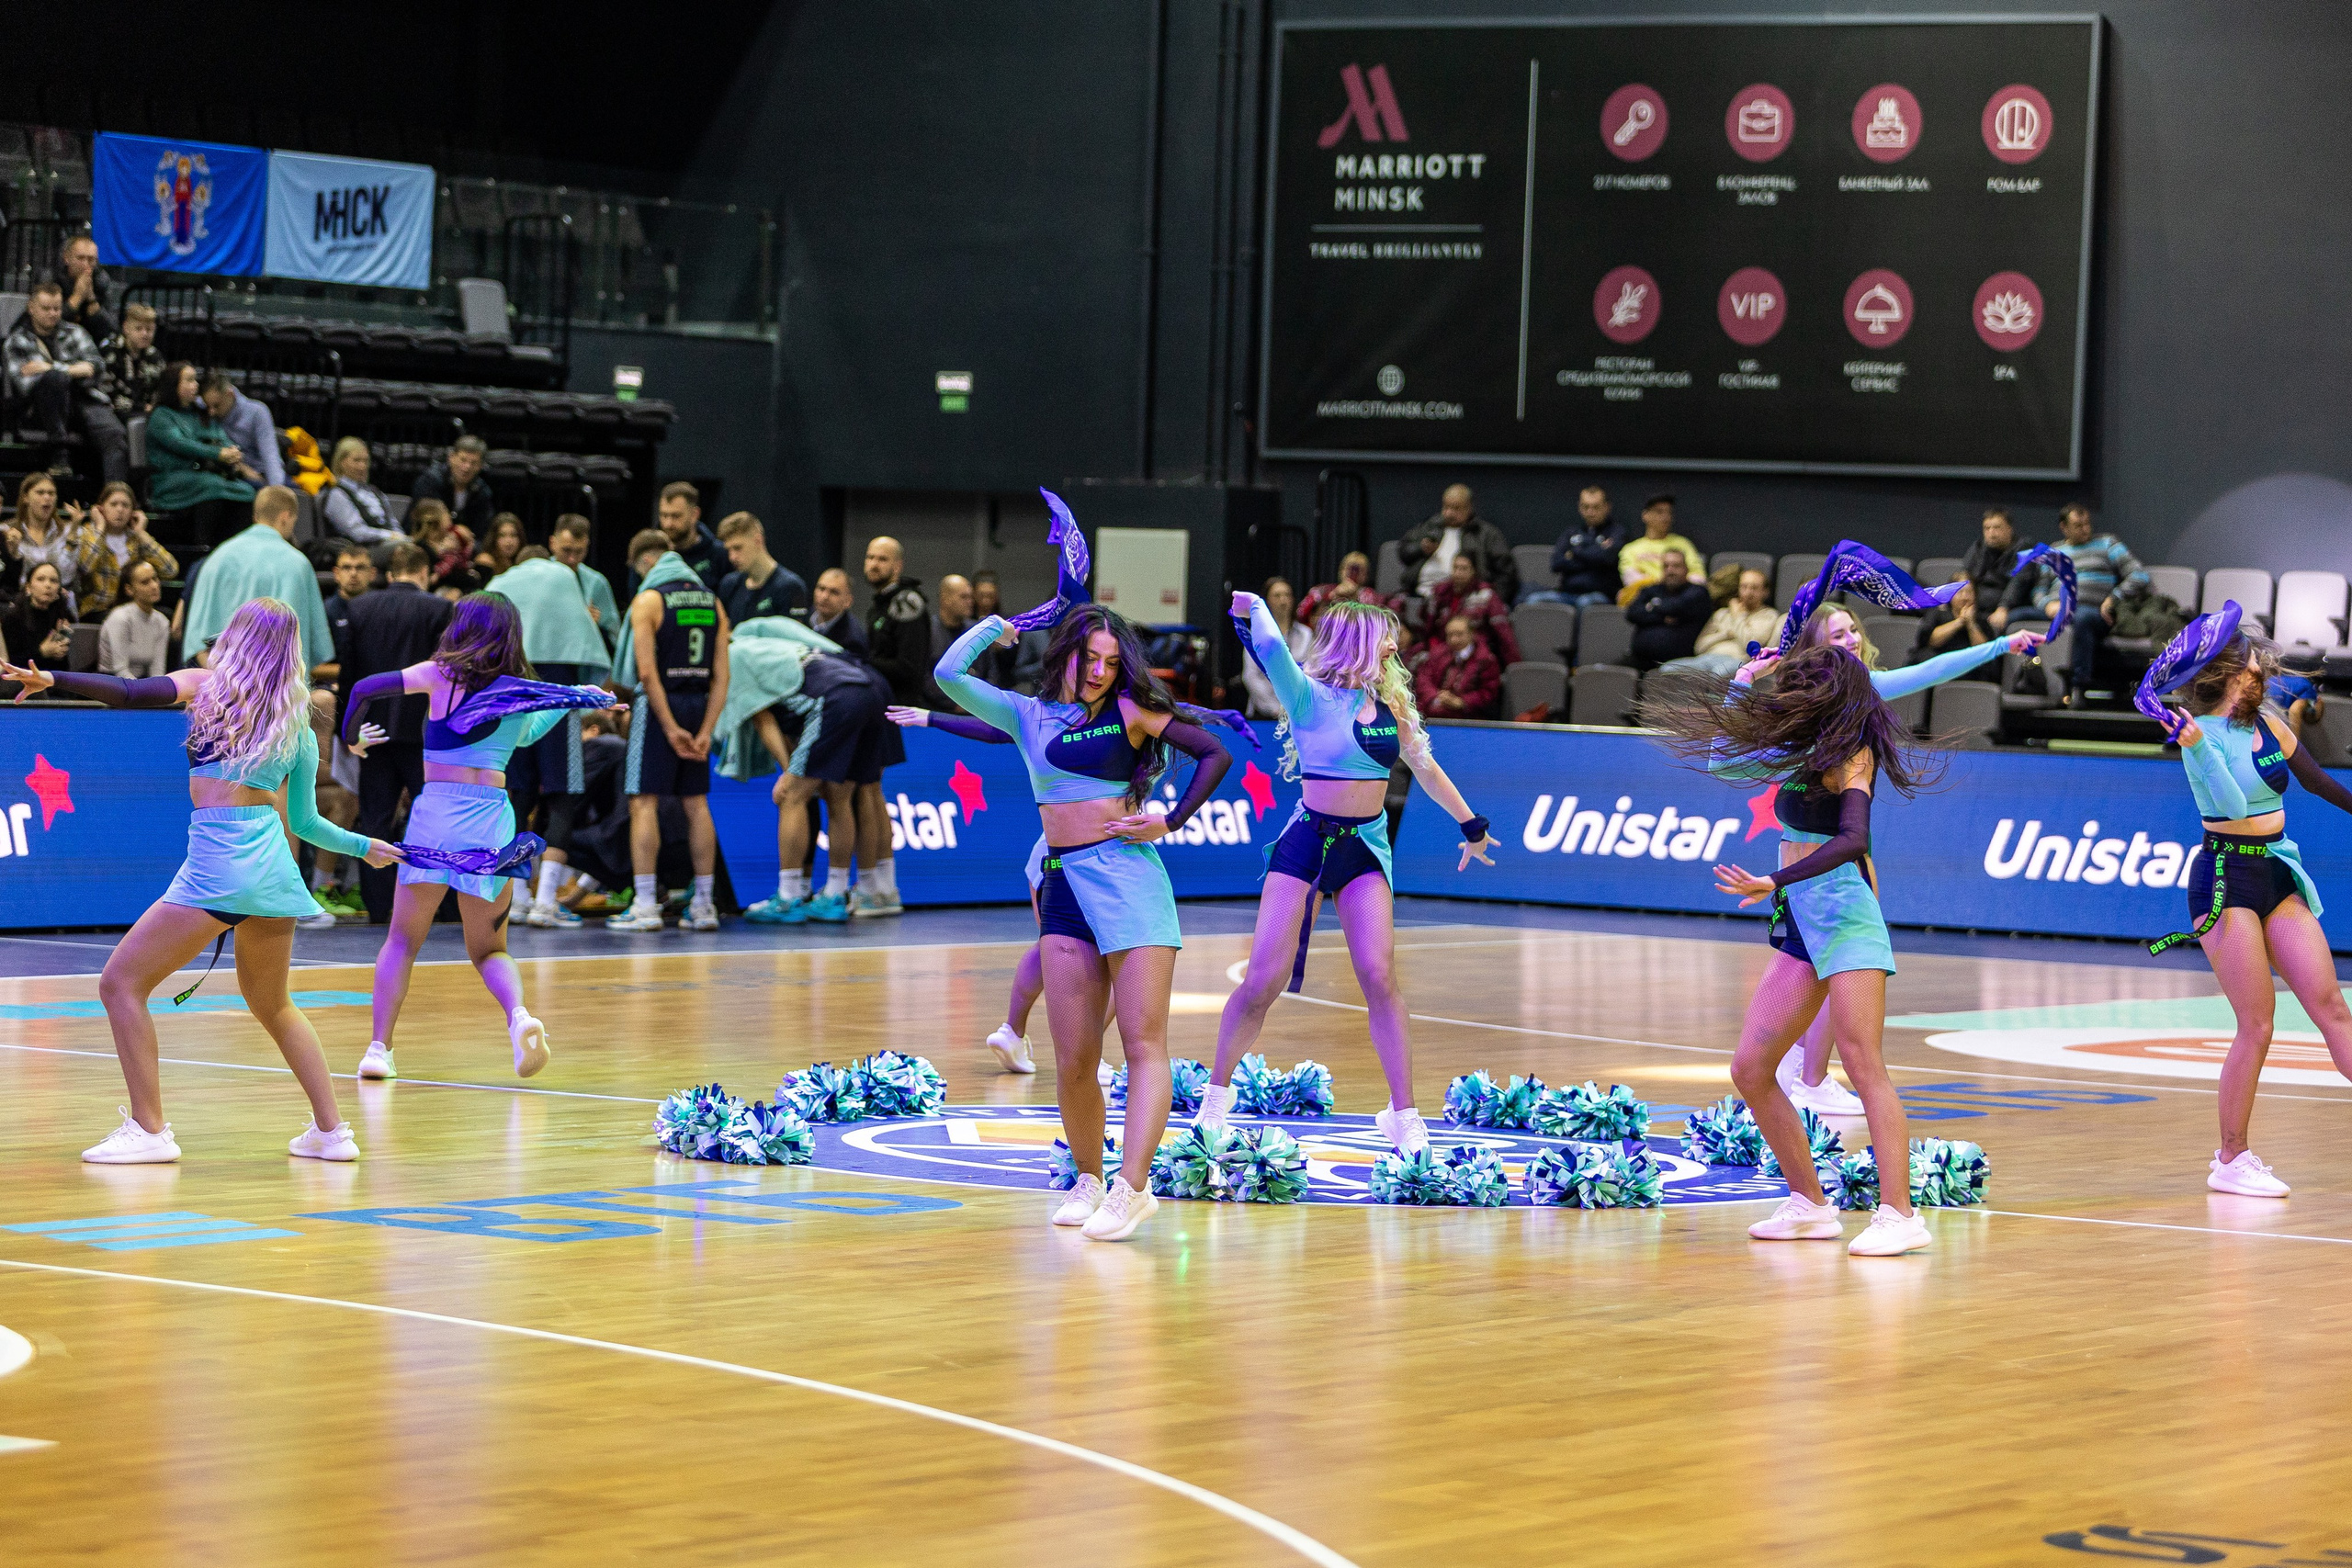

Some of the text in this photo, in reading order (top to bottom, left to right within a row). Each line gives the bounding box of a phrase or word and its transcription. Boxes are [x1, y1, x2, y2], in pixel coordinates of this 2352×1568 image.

[1335, 153, 1486, 179] MARRIOTT
[1334, 186, 1424, 211] MINSK
[1309, 243, 1370, 259] TRAVEL
[1730, 292, 1776, 320] VIP
[688, 627, 705, 665] 9
[1361, 727, 1396, 736] BETER
[2257, 750, 2285, 767] BETER
[1522, 795, 1741, 862] Unistar
[2199, 891, 2224, 933] BETERA
[290, 1179, 964, 1243] ВТБ
